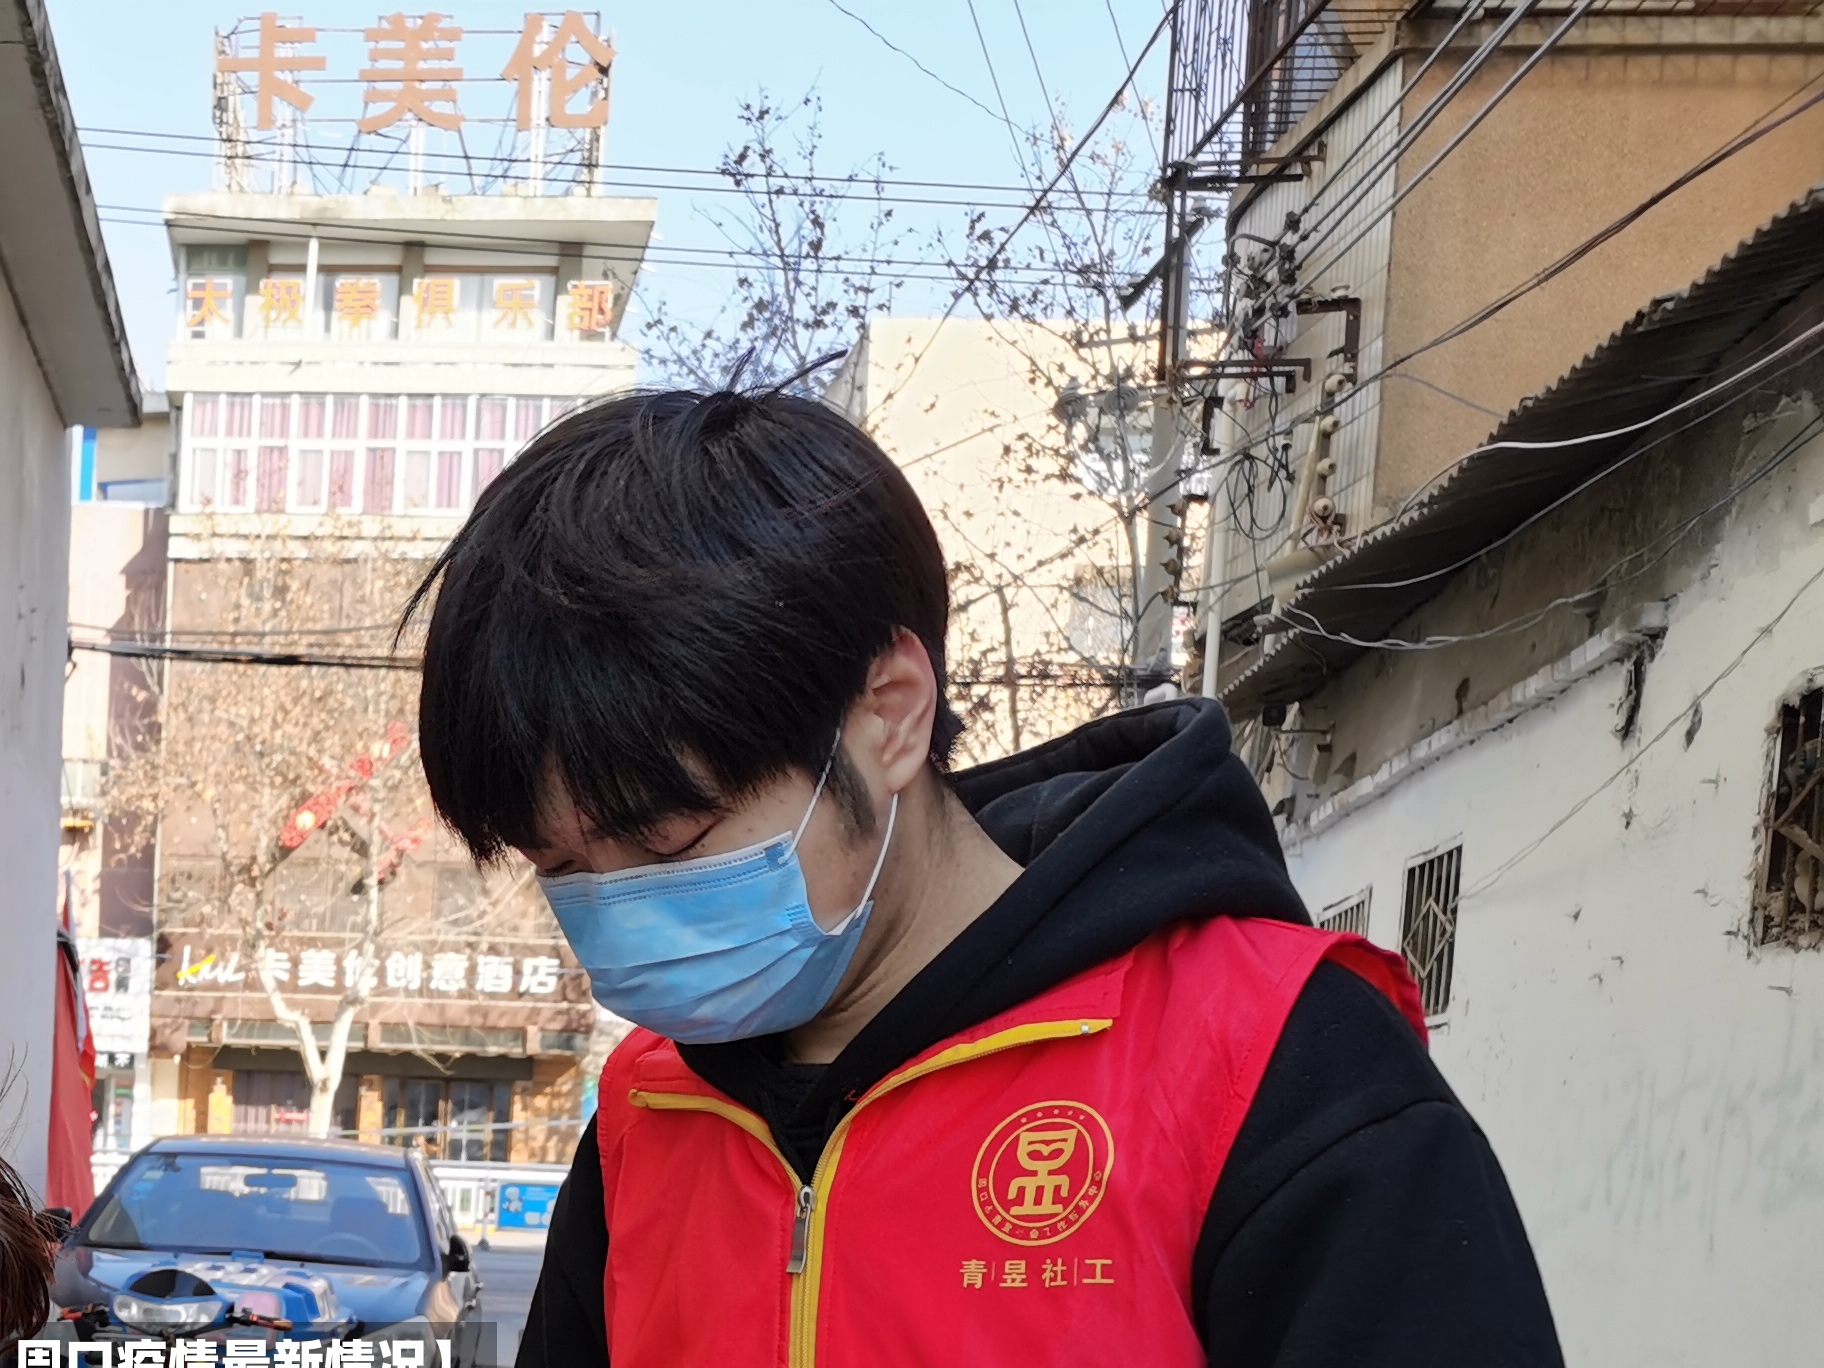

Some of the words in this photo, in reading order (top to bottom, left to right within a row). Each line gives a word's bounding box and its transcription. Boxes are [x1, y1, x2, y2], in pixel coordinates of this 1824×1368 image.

[217, 10, 617, 133] 卡美伦
[187, 277, 615, 330] 太极拳俱乐部
